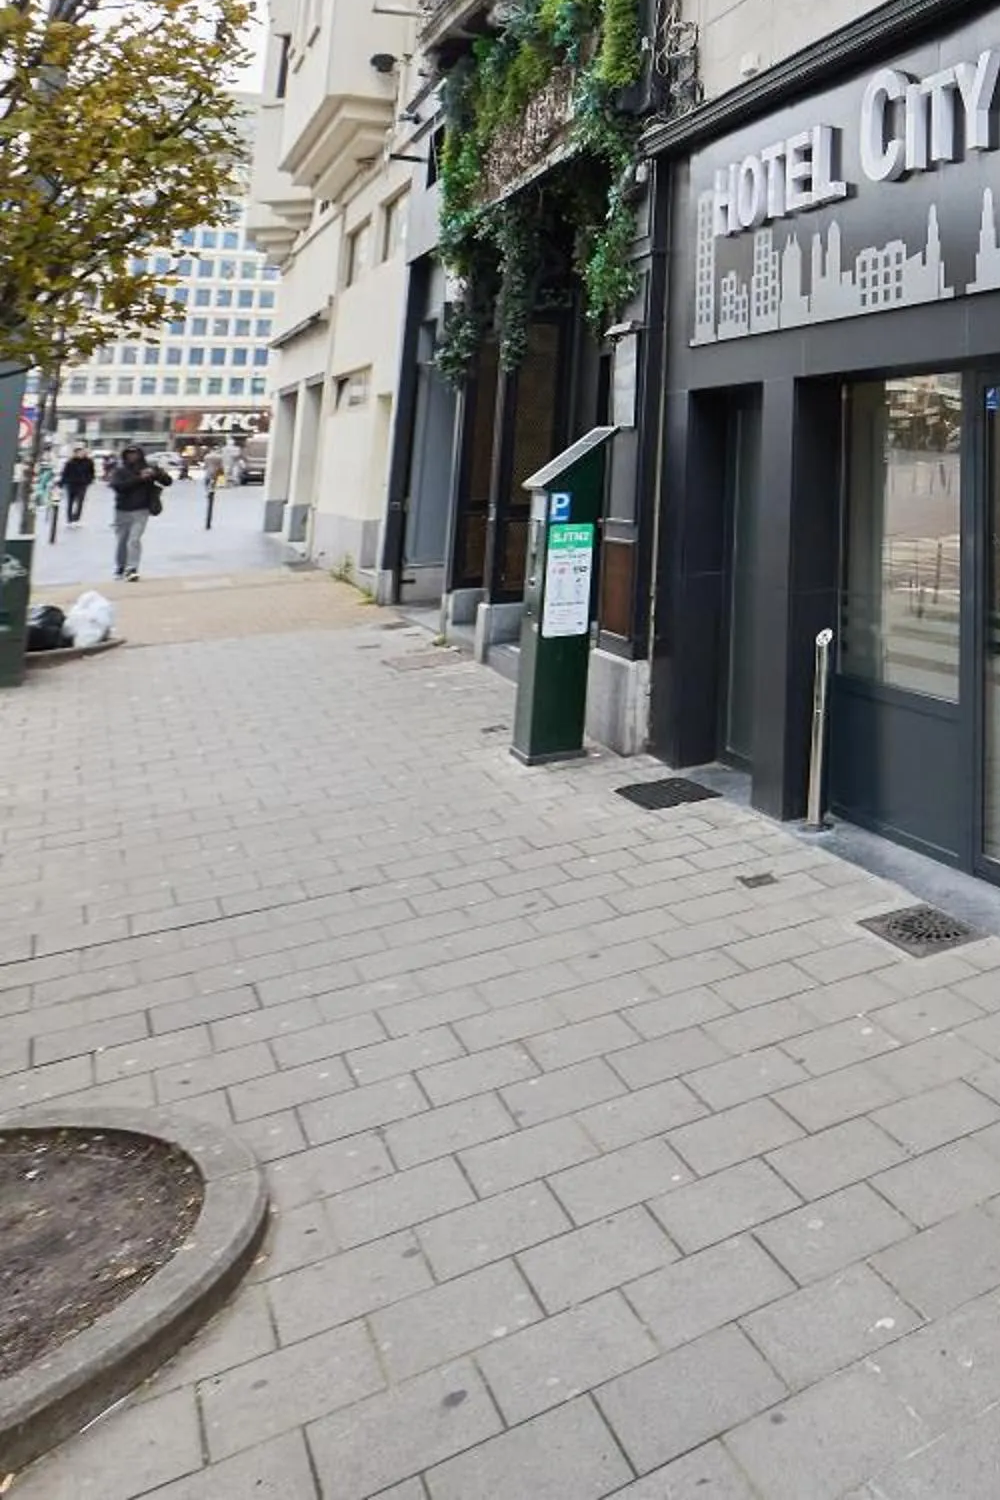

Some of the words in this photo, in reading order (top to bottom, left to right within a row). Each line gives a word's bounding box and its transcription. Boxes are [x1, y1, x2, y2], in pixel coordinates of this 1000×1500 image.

[713, 124, 848, 236] HOTEL
[198, 412, 261, 432] KFC
[551, 493, 570, 515] P
